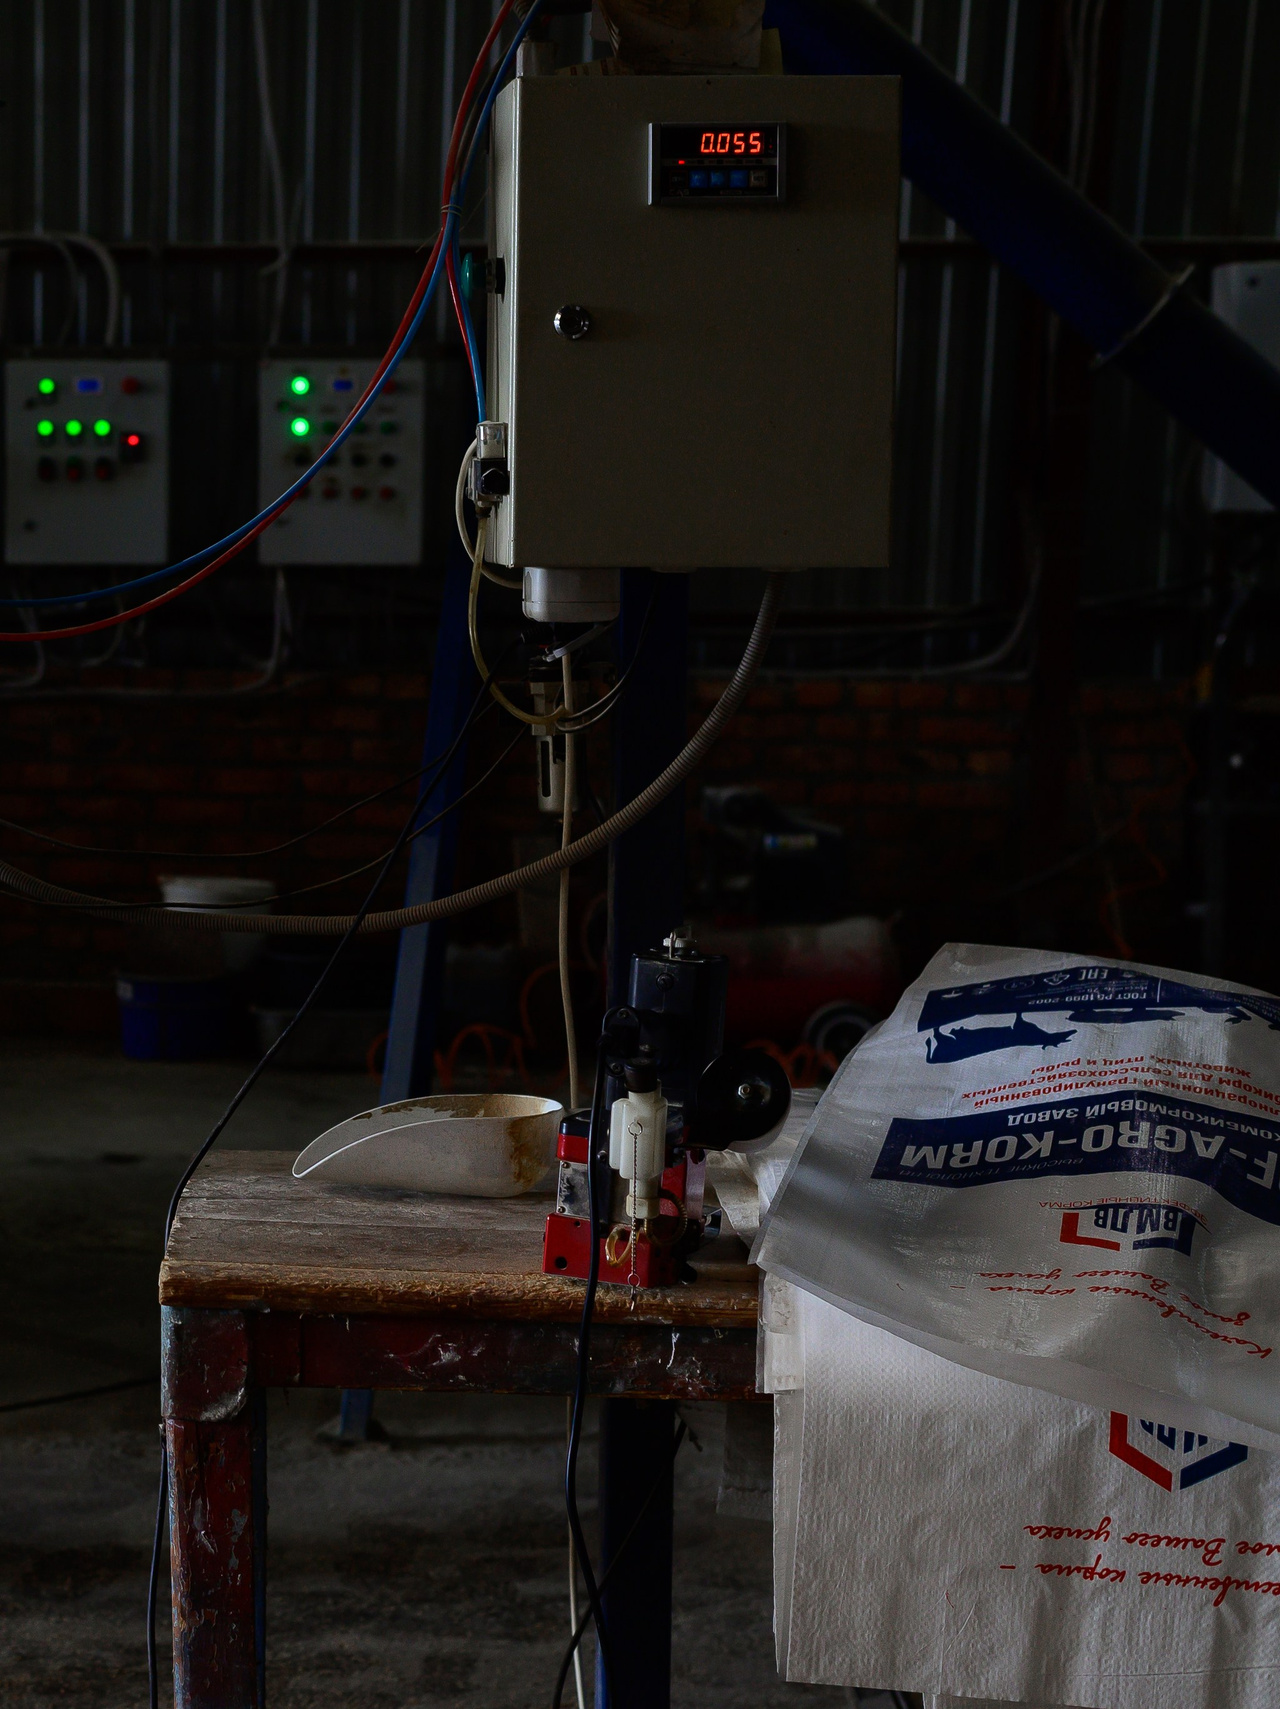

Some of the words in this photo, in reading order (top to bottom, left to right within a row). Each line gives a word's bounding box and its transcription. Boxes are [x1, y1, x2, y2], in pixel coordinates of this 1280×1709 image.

[700, 132, 762, 154] 0.055
[1031, 1058, 1080, 1075] рыбы
[1102, 1055, 1144, 1066] птиц
[961, 1066, 1172, 1100] сельскохозяйственных
[1177, 1071, 1213, 1082] для
[974, 1076, 1137, 1109] гранулированный
[1007, 1107, 1080, 1126] ЗАВОД
[899, 1120, 1280, 1190] F-AGRO-KORM
[1006, 1157, 1084, 1173] ВЫСОКИЕ
[898, 1167, 1001, 1181] ТЕХНОЛОГИИ
[1038, 1199, 1093, 1208] КОРМА
[1093, 1207, 1179, 1234] ВМЛВ
[974, 1268, 1062, 1282] успеха
[1072, 1269, 1173, 1295] Вашего
[984, 1284, 1076, 1298] корма
[1178, 1293, 1251, 1326] залог
[1086, 1285, 1272, 1359] Качественные
[1024, 1516, 1111, 1543] успеха
[1122, 1532, 1226, 1566] Вашего
[1035, 1554, 1126, 1583] корма
